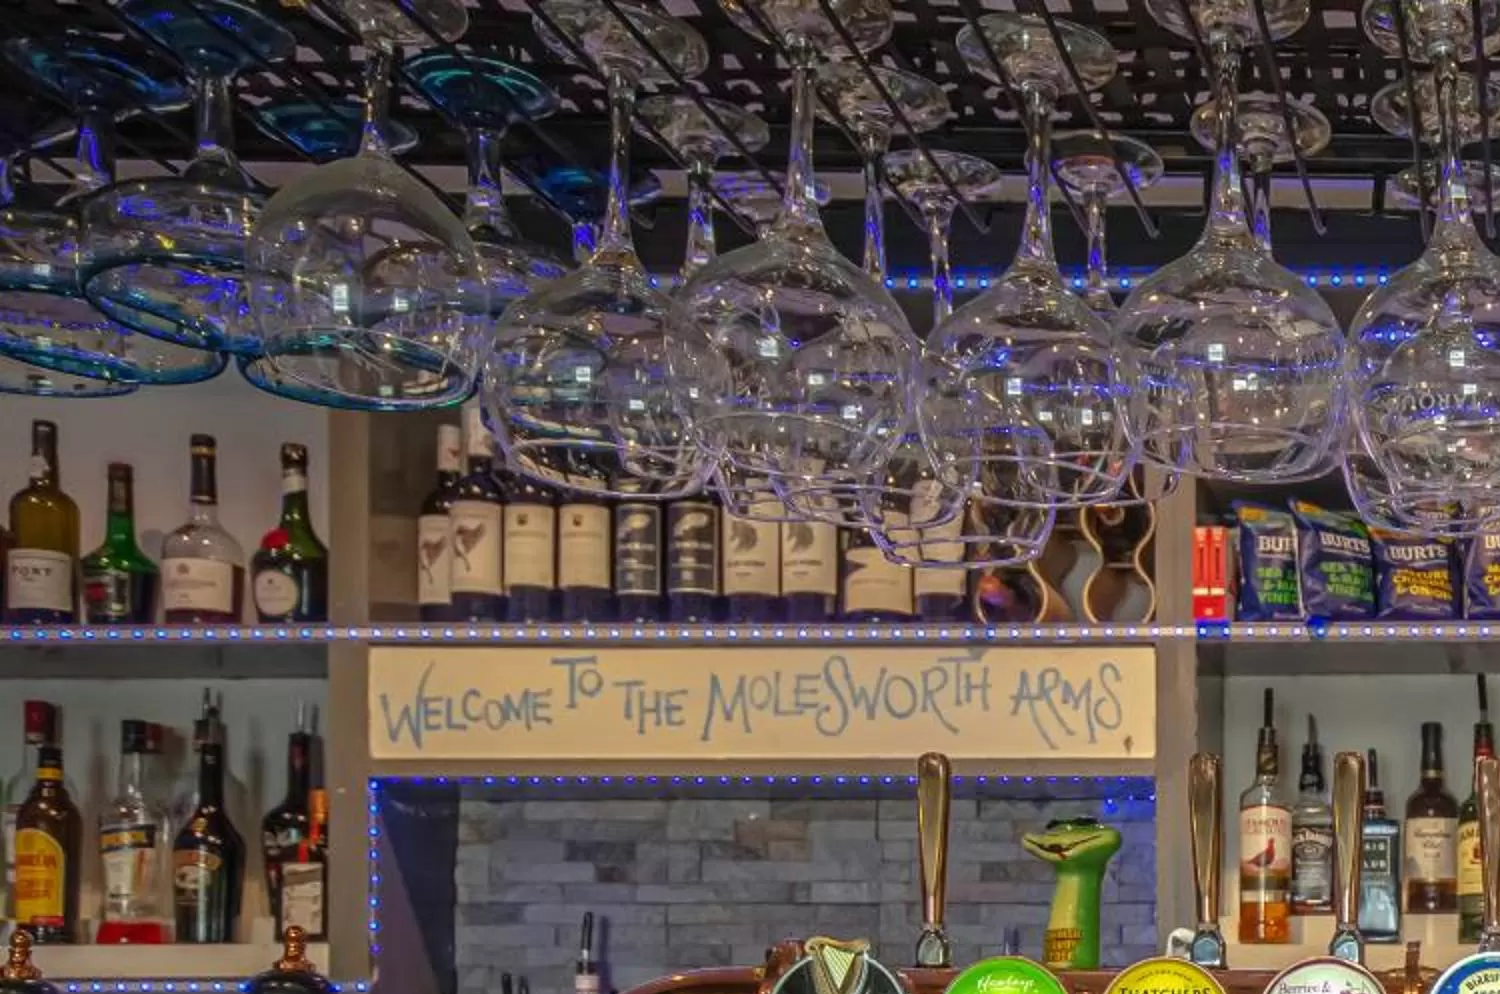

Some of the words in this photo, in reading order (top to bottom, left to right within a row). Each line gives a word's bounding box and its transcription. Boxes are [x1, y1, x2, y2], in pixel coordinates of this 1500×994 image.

[380, 660, 552, 749] WELCOME
[551, 655, 603, 709] TO
[612, 679, 689, 735] THE
[701, 655, 992, 741] MOLESWORTH
